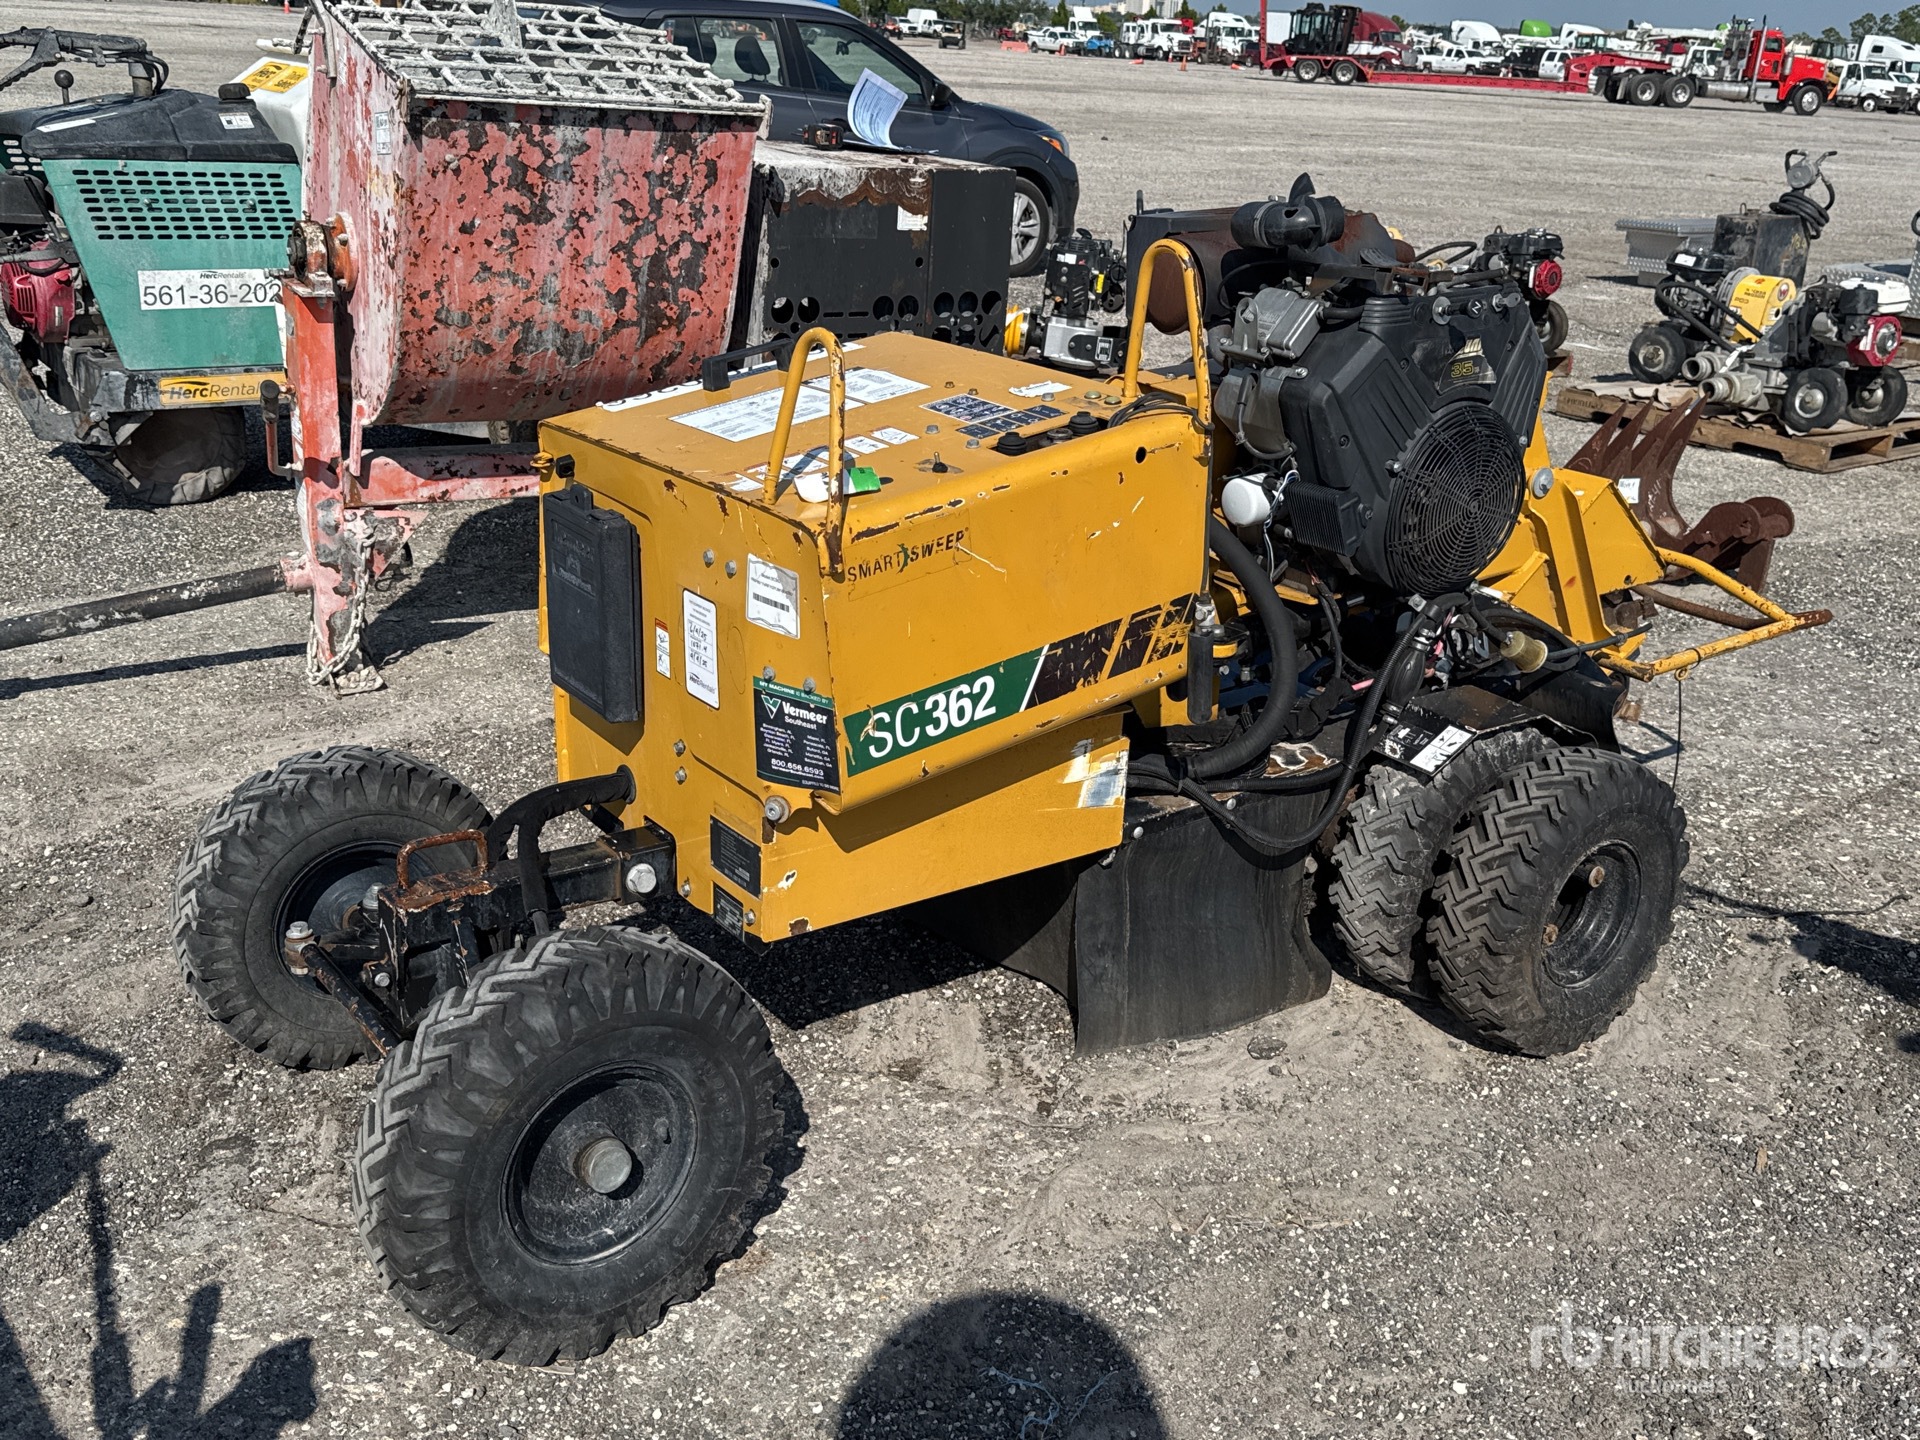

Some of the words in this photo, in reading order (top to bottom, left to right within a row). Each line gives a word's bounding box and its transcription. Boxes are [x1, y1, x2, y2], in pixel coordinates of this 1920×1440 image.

[1451, 361, 1474, 377] 35
[169, 381, 262, 400] HercRental
[847, 550, 902, 583] SMART
[769, 683, 795, 695] MACHINE
[782, 701, 828, 724] Vermeer
[784, 715, 817, 730] Southeast
